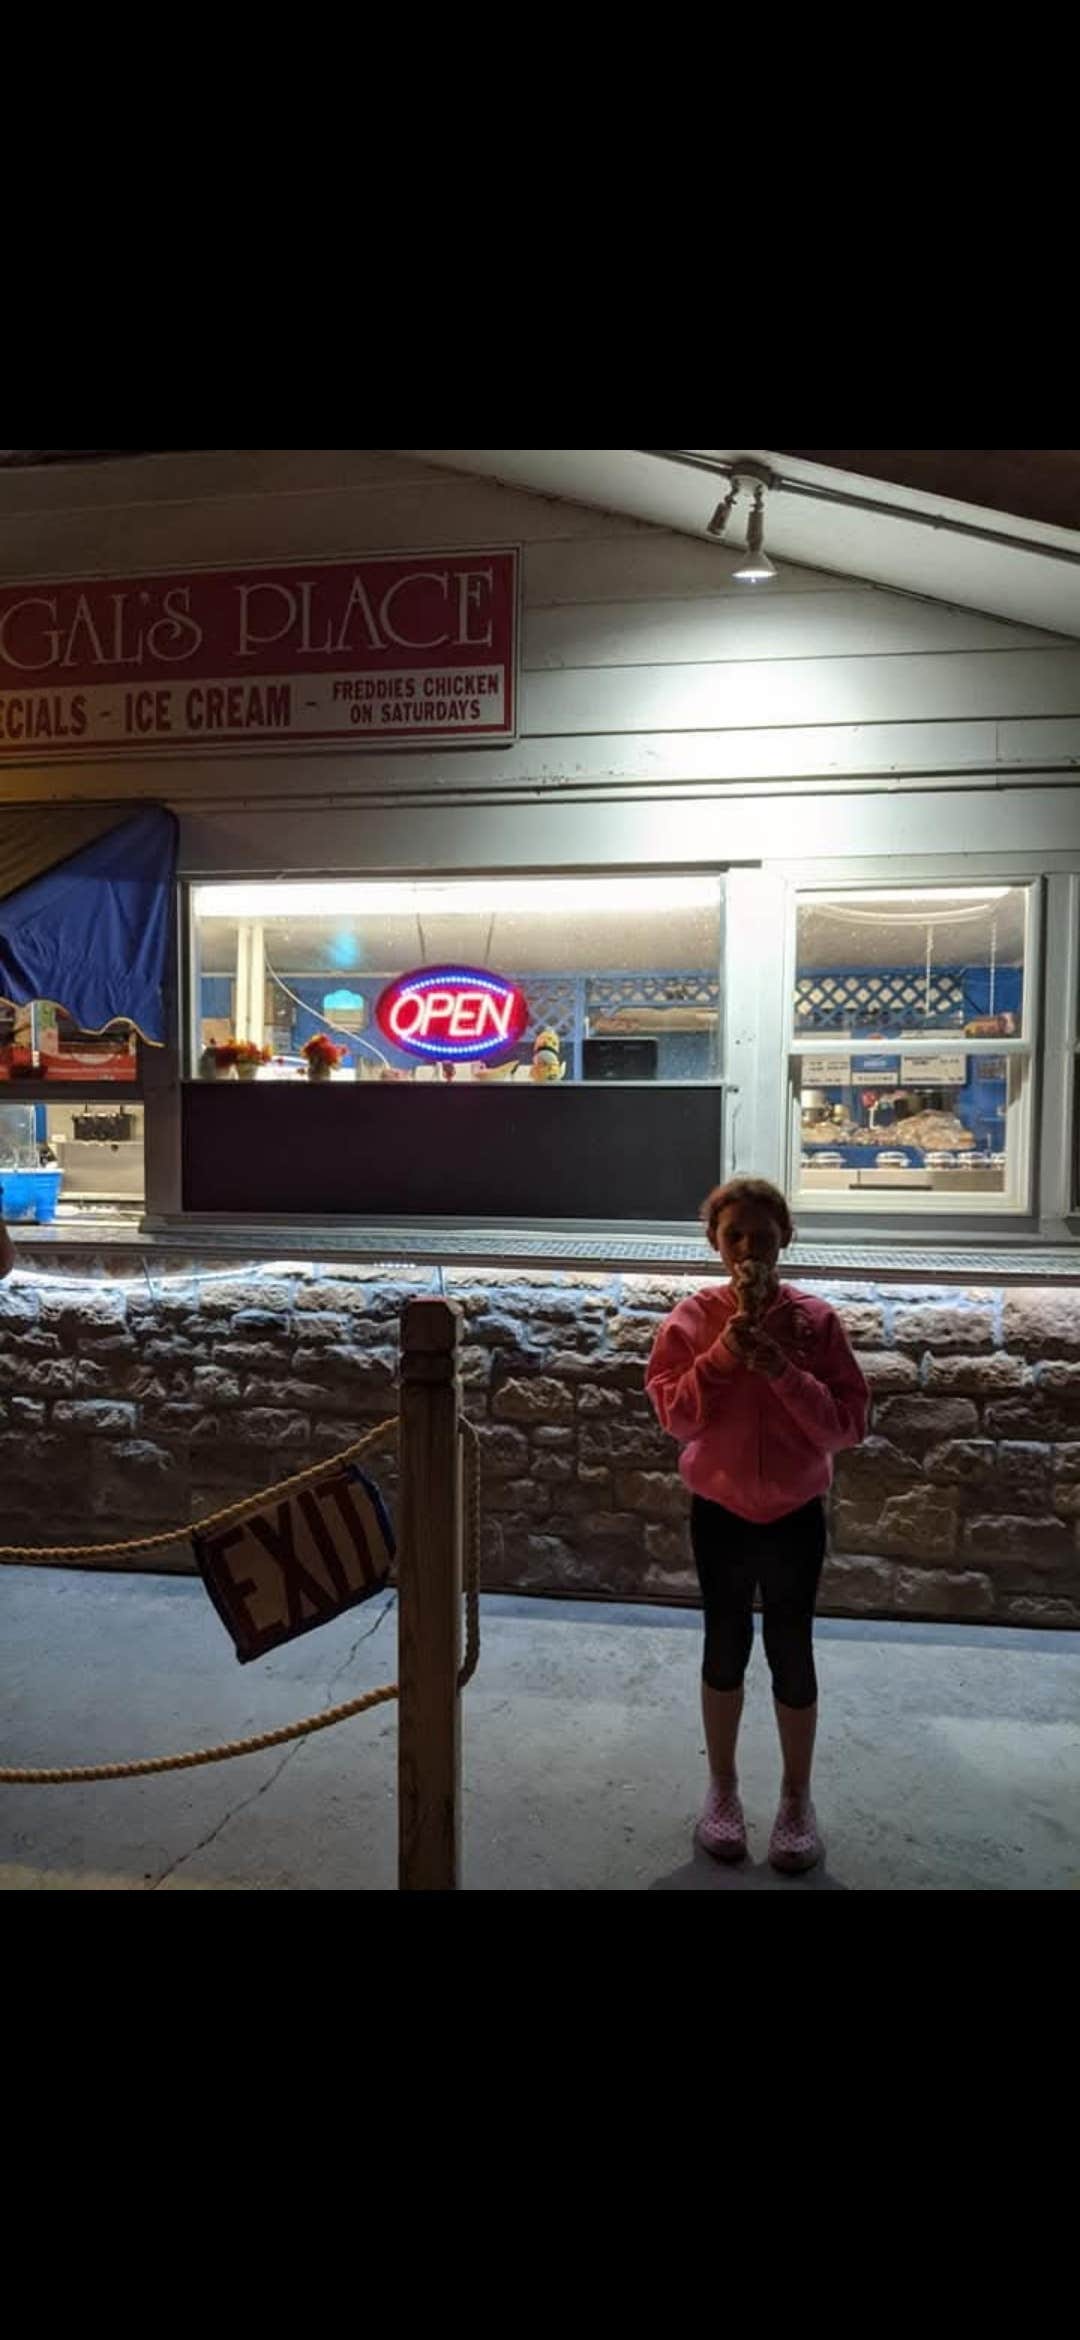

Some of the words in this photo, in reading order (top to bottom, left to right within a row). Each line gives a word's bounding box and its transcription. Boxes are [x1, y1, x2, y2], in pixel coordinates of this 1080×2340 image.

[0, 586, 202, 670] GAL'S
[232, 569, 494, 655] PLACE
[125, 690, 171, 733] ICE
[187, 685, 290, 730] CREAM
[333, 677, 415, 701] FREDDIES
[423, 673, 498, 697] CHICKEN
[350, 703, 373, 724] ON
[381, 699, 481, 722] SATURDAYS
[389, 992, 514, 1039] OPEN
[205, 1474, 377, 1651] EXIT
